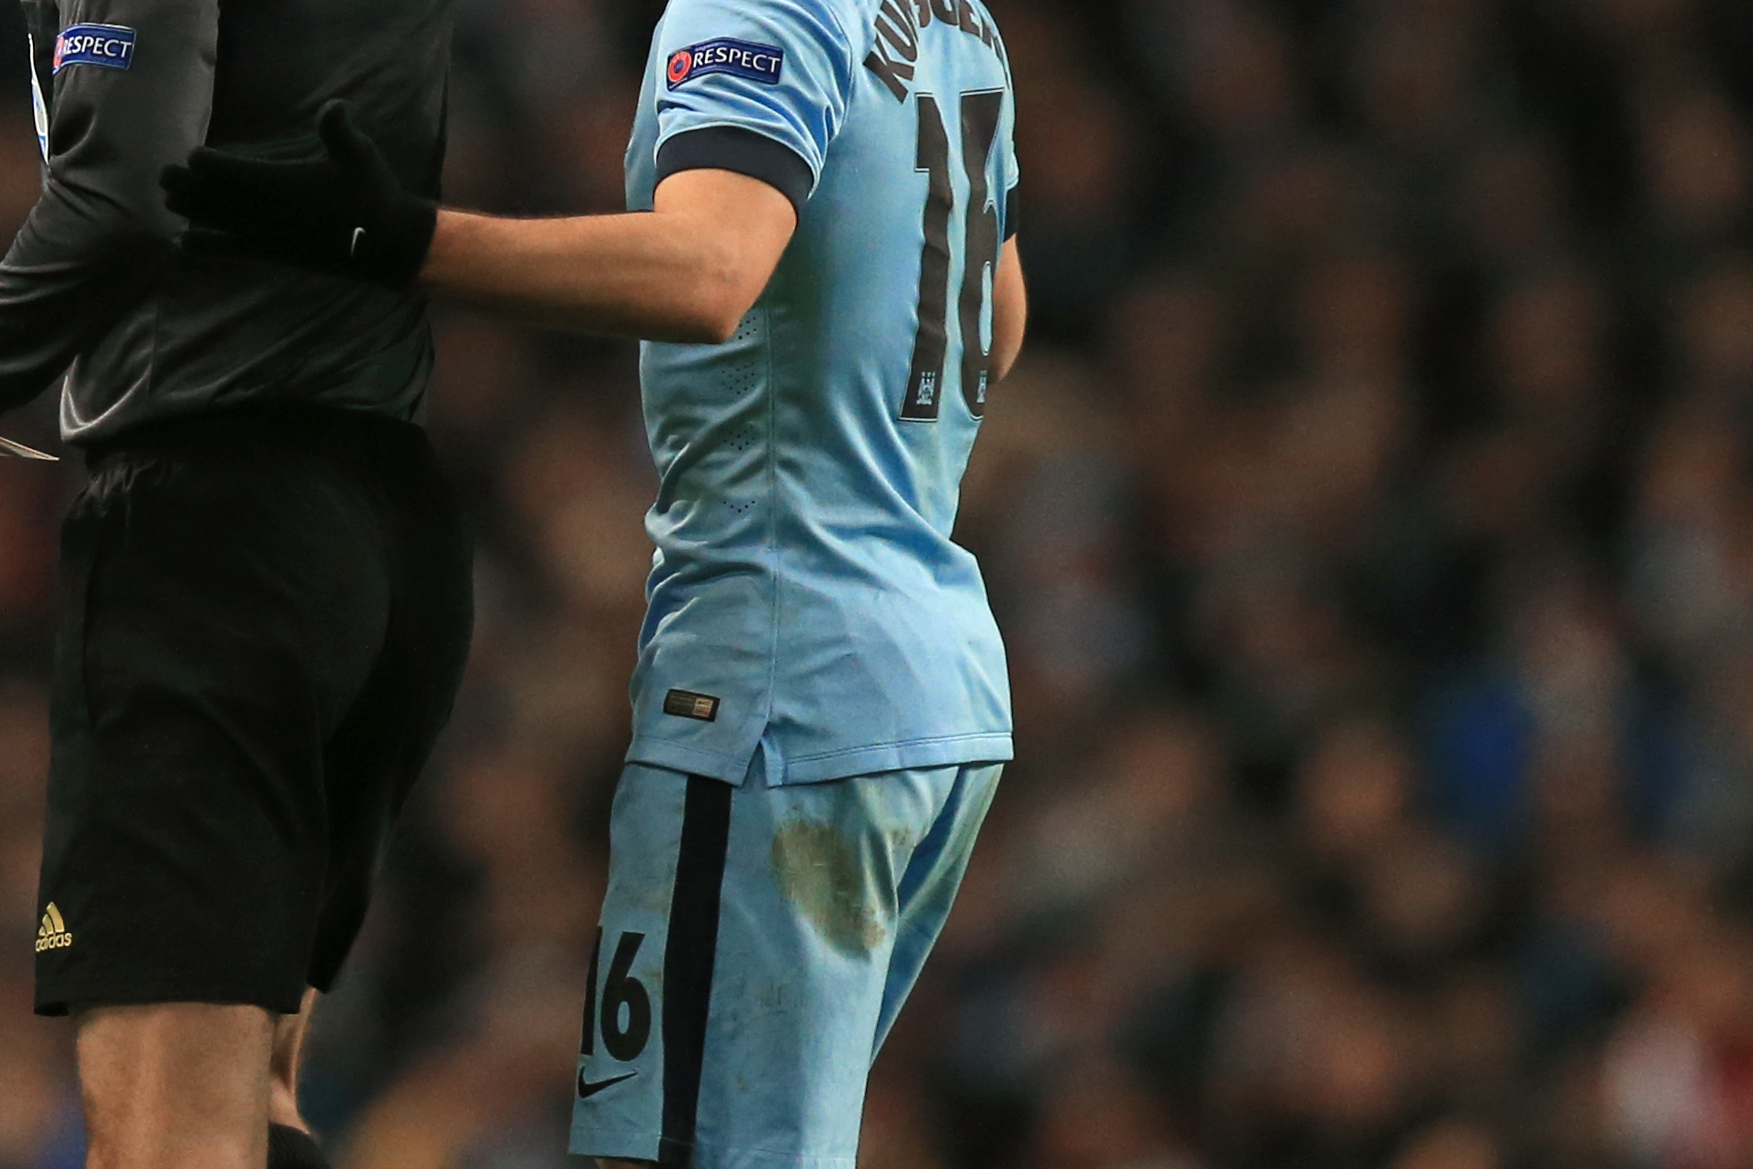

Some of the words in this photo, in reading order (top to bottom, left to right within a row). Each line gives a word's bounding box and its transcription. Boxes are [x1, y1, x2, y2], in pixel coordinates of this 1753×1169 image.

[692, 46, 781, 73] RESPECT
[898, 87, 1005, 423] 16
[35, 932, 73, 952] adidas
[580, 925, 652, 1062] 16
